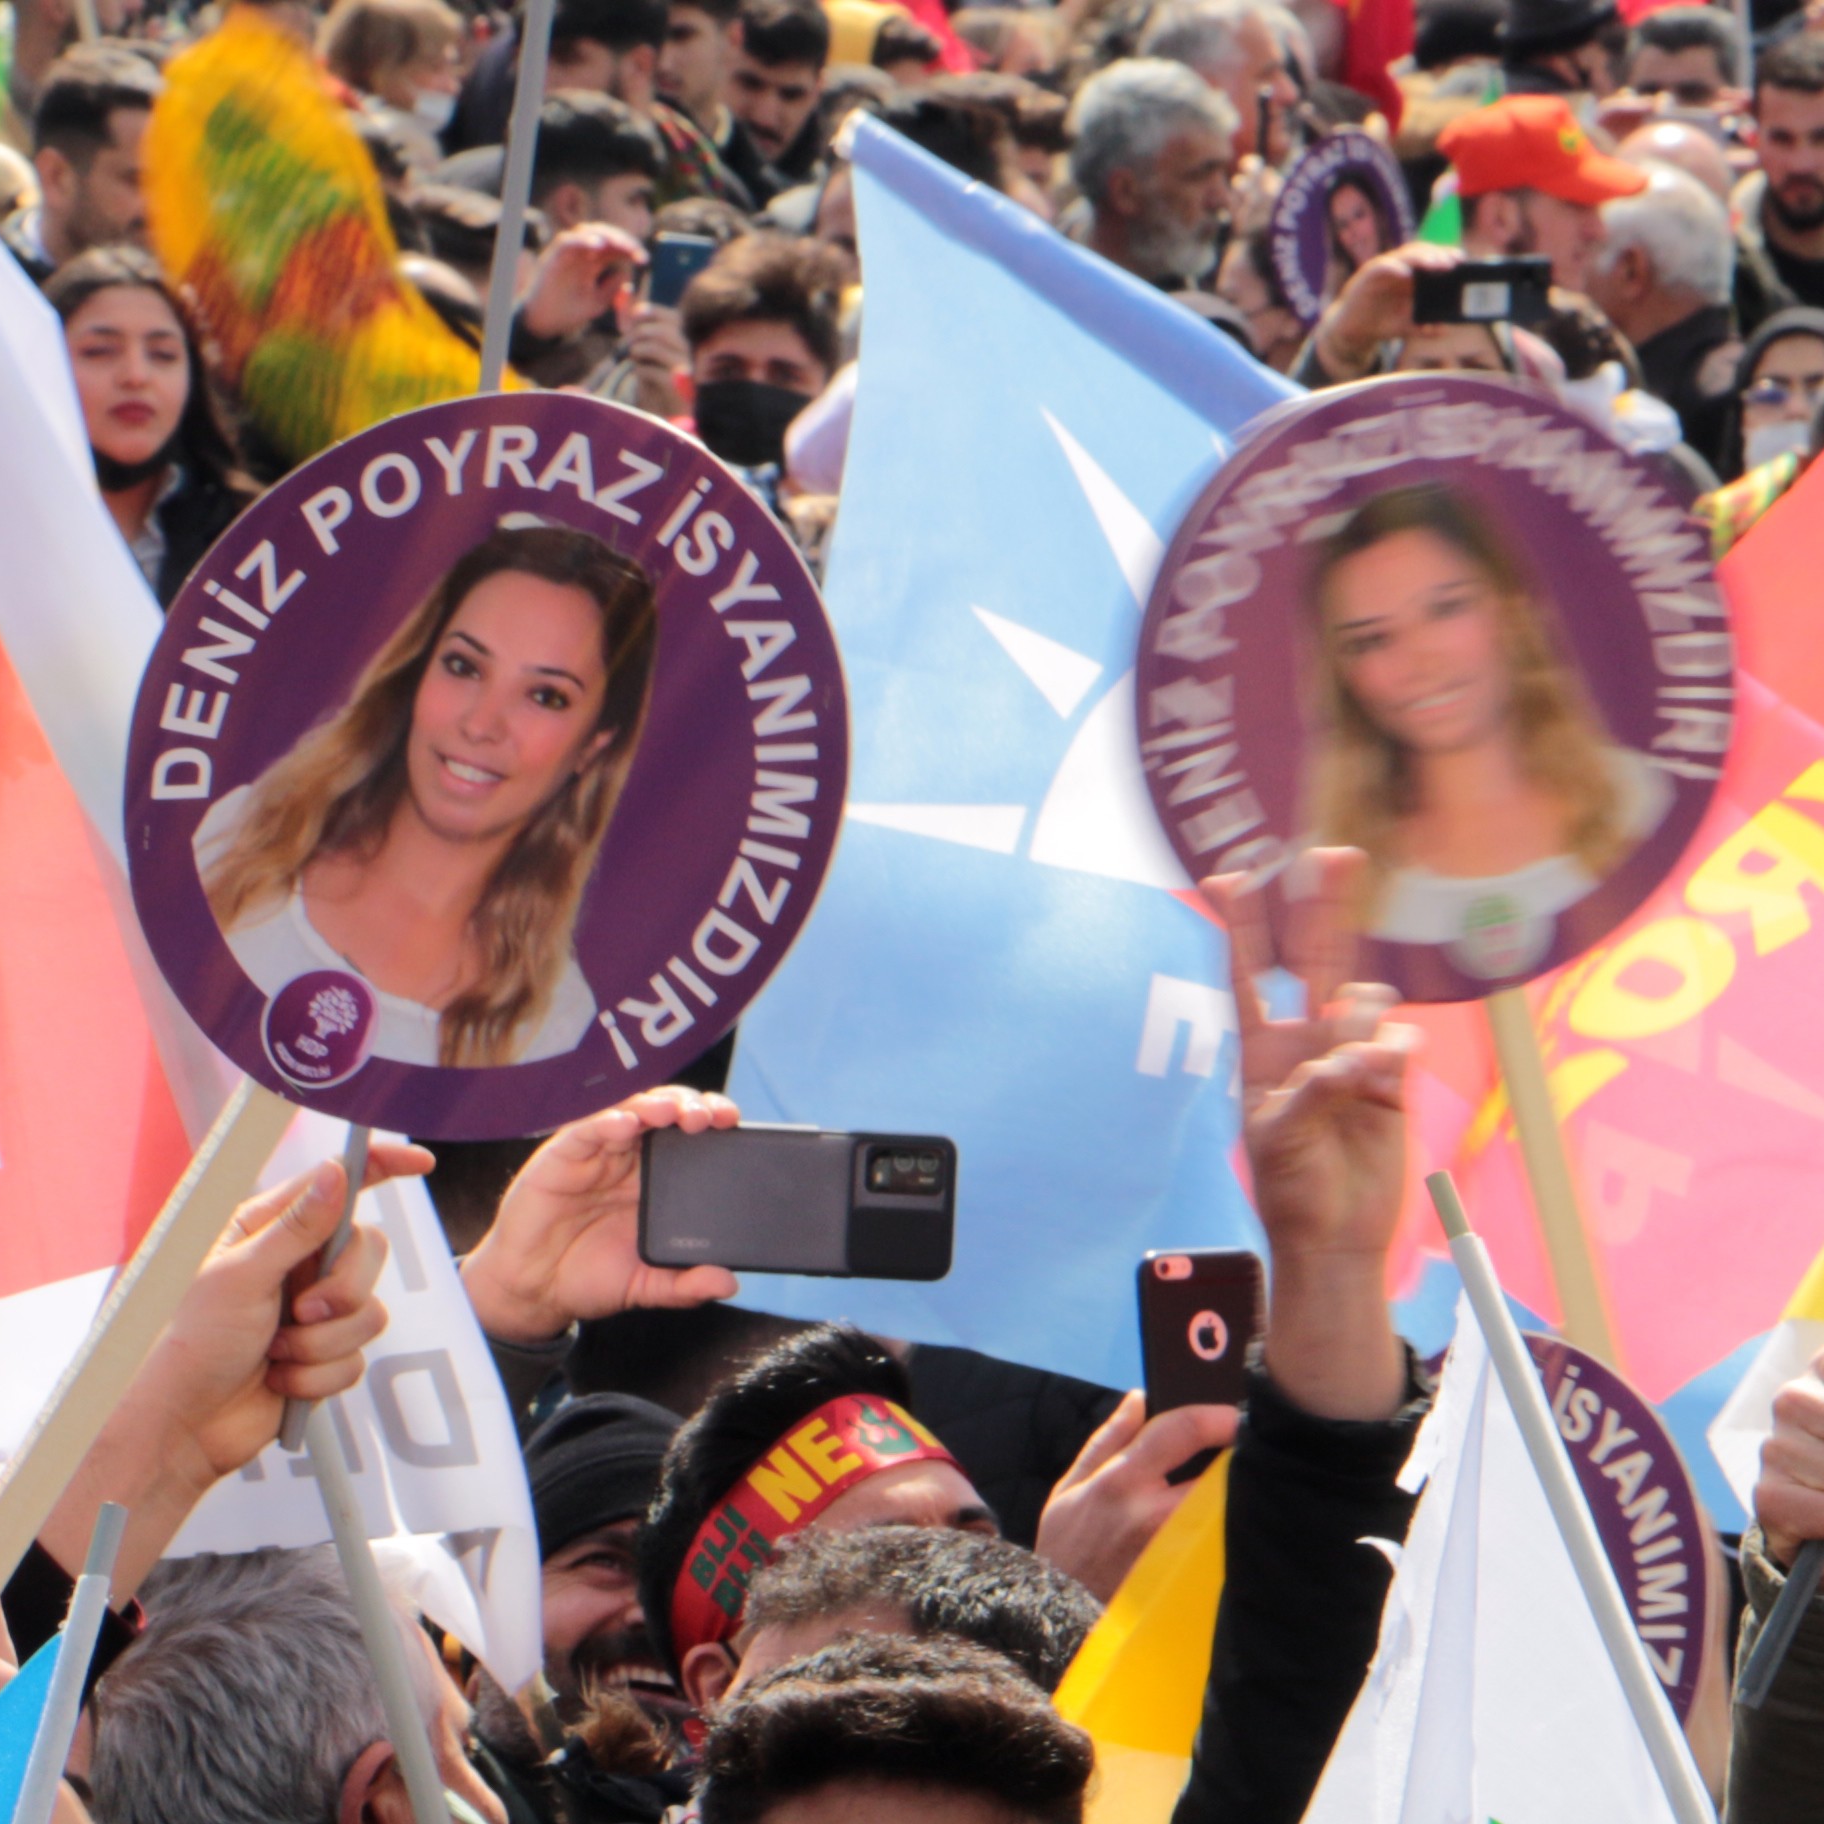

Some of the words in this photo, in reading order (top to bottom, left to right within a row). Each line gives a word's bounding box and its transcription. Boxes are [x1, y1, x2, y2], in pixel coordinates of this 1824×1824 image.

[151, 541, 306, 800] DENİZ
[301, 425, 662, 555] POYRAZ
[600, 477, 819, 1069] İSYANIMIZDIR!
